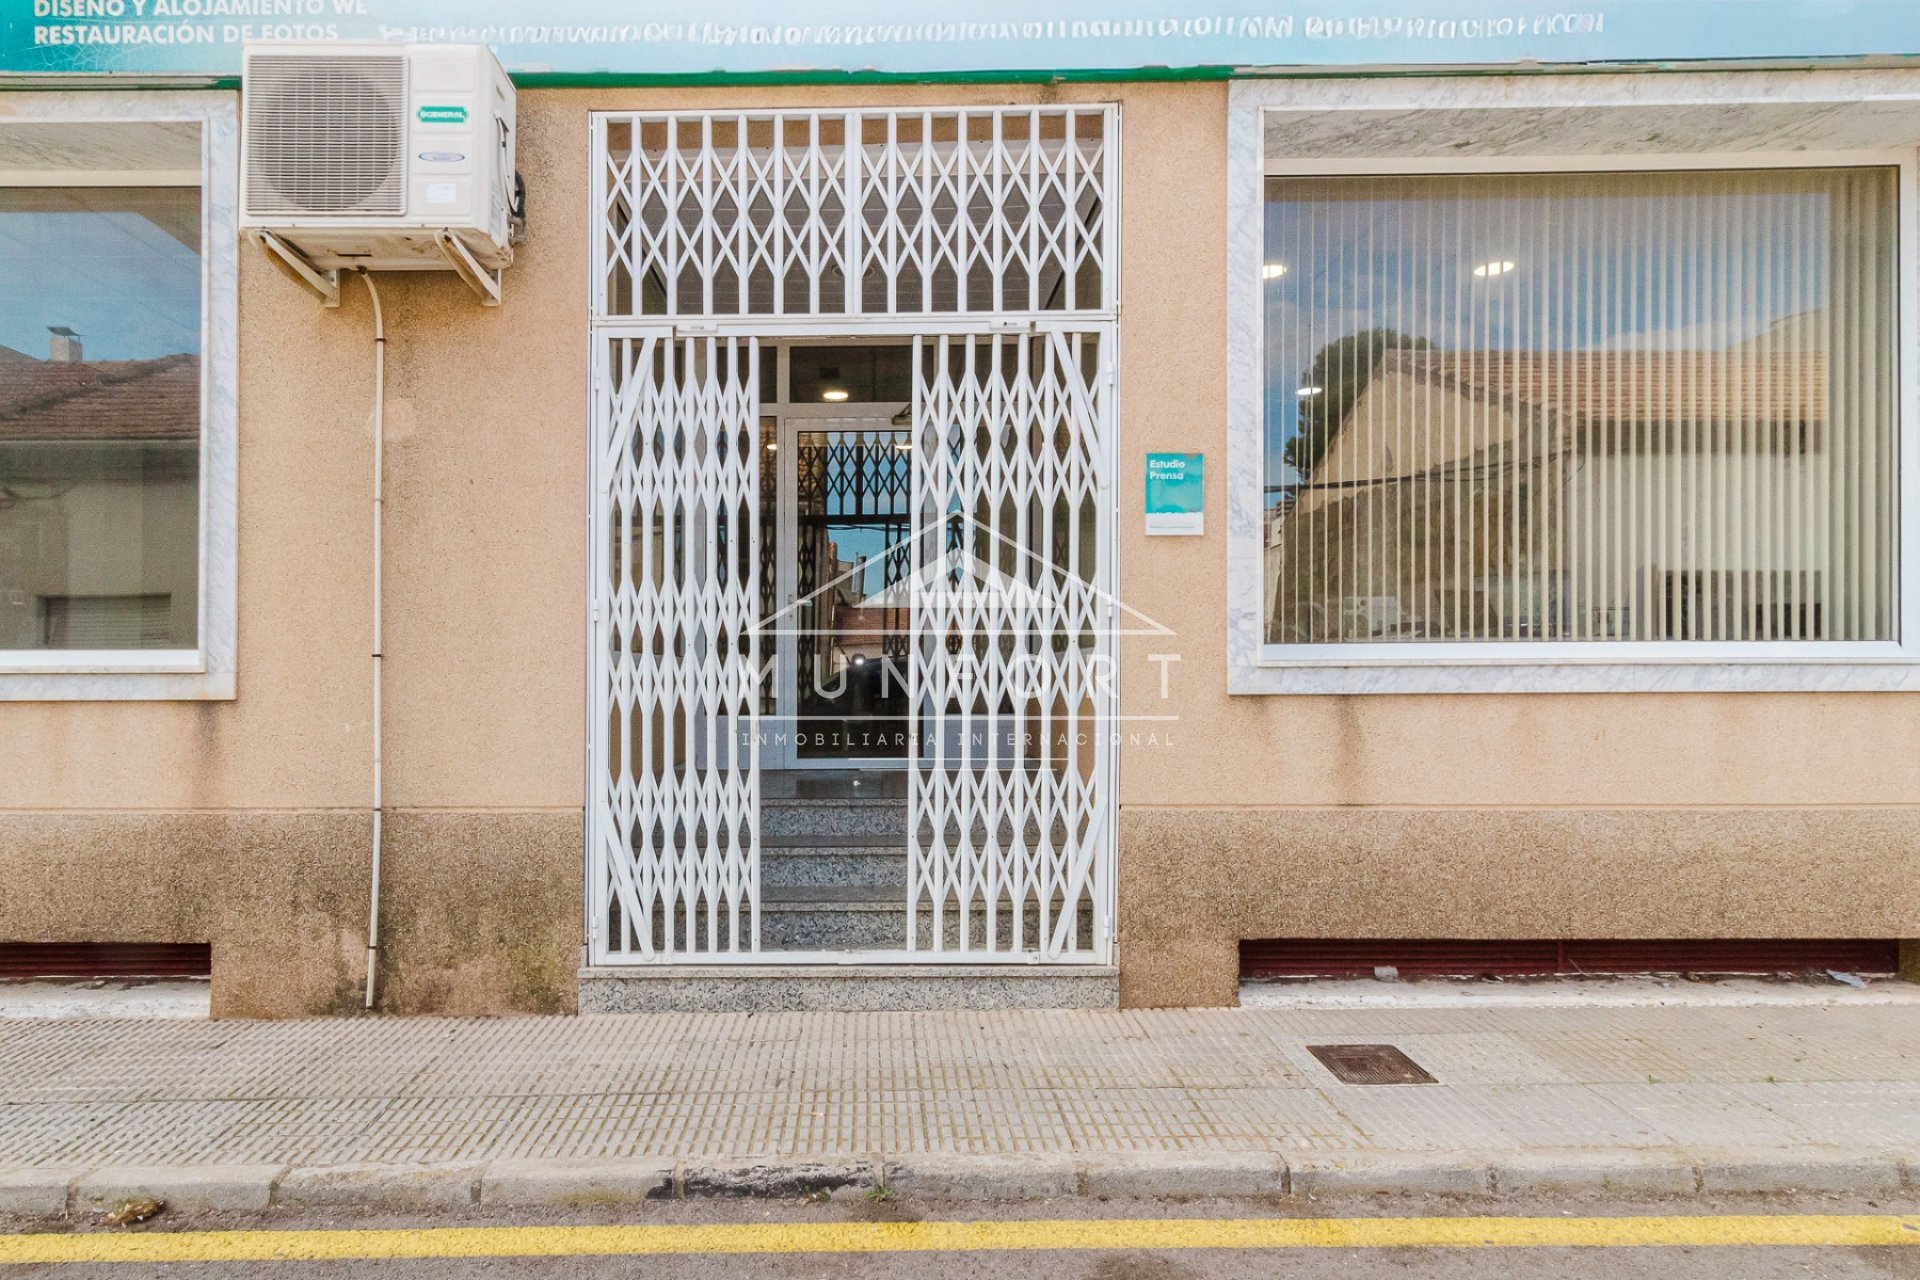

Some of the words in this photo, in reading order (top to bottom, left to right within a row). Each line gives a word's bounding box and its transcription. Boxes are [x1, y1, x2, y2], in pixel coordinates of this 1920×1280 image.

[131, 0, 146, 16] Y
[153, 0, 325, 16] ALOJAMIENTO
[33, 19, 215, 45] RESTAURACIÓN
[223, 24, 253, 44] DE
[1150, 459, 1186, 469] Estudio
[1150, 471, 1184, 480] Prensa
